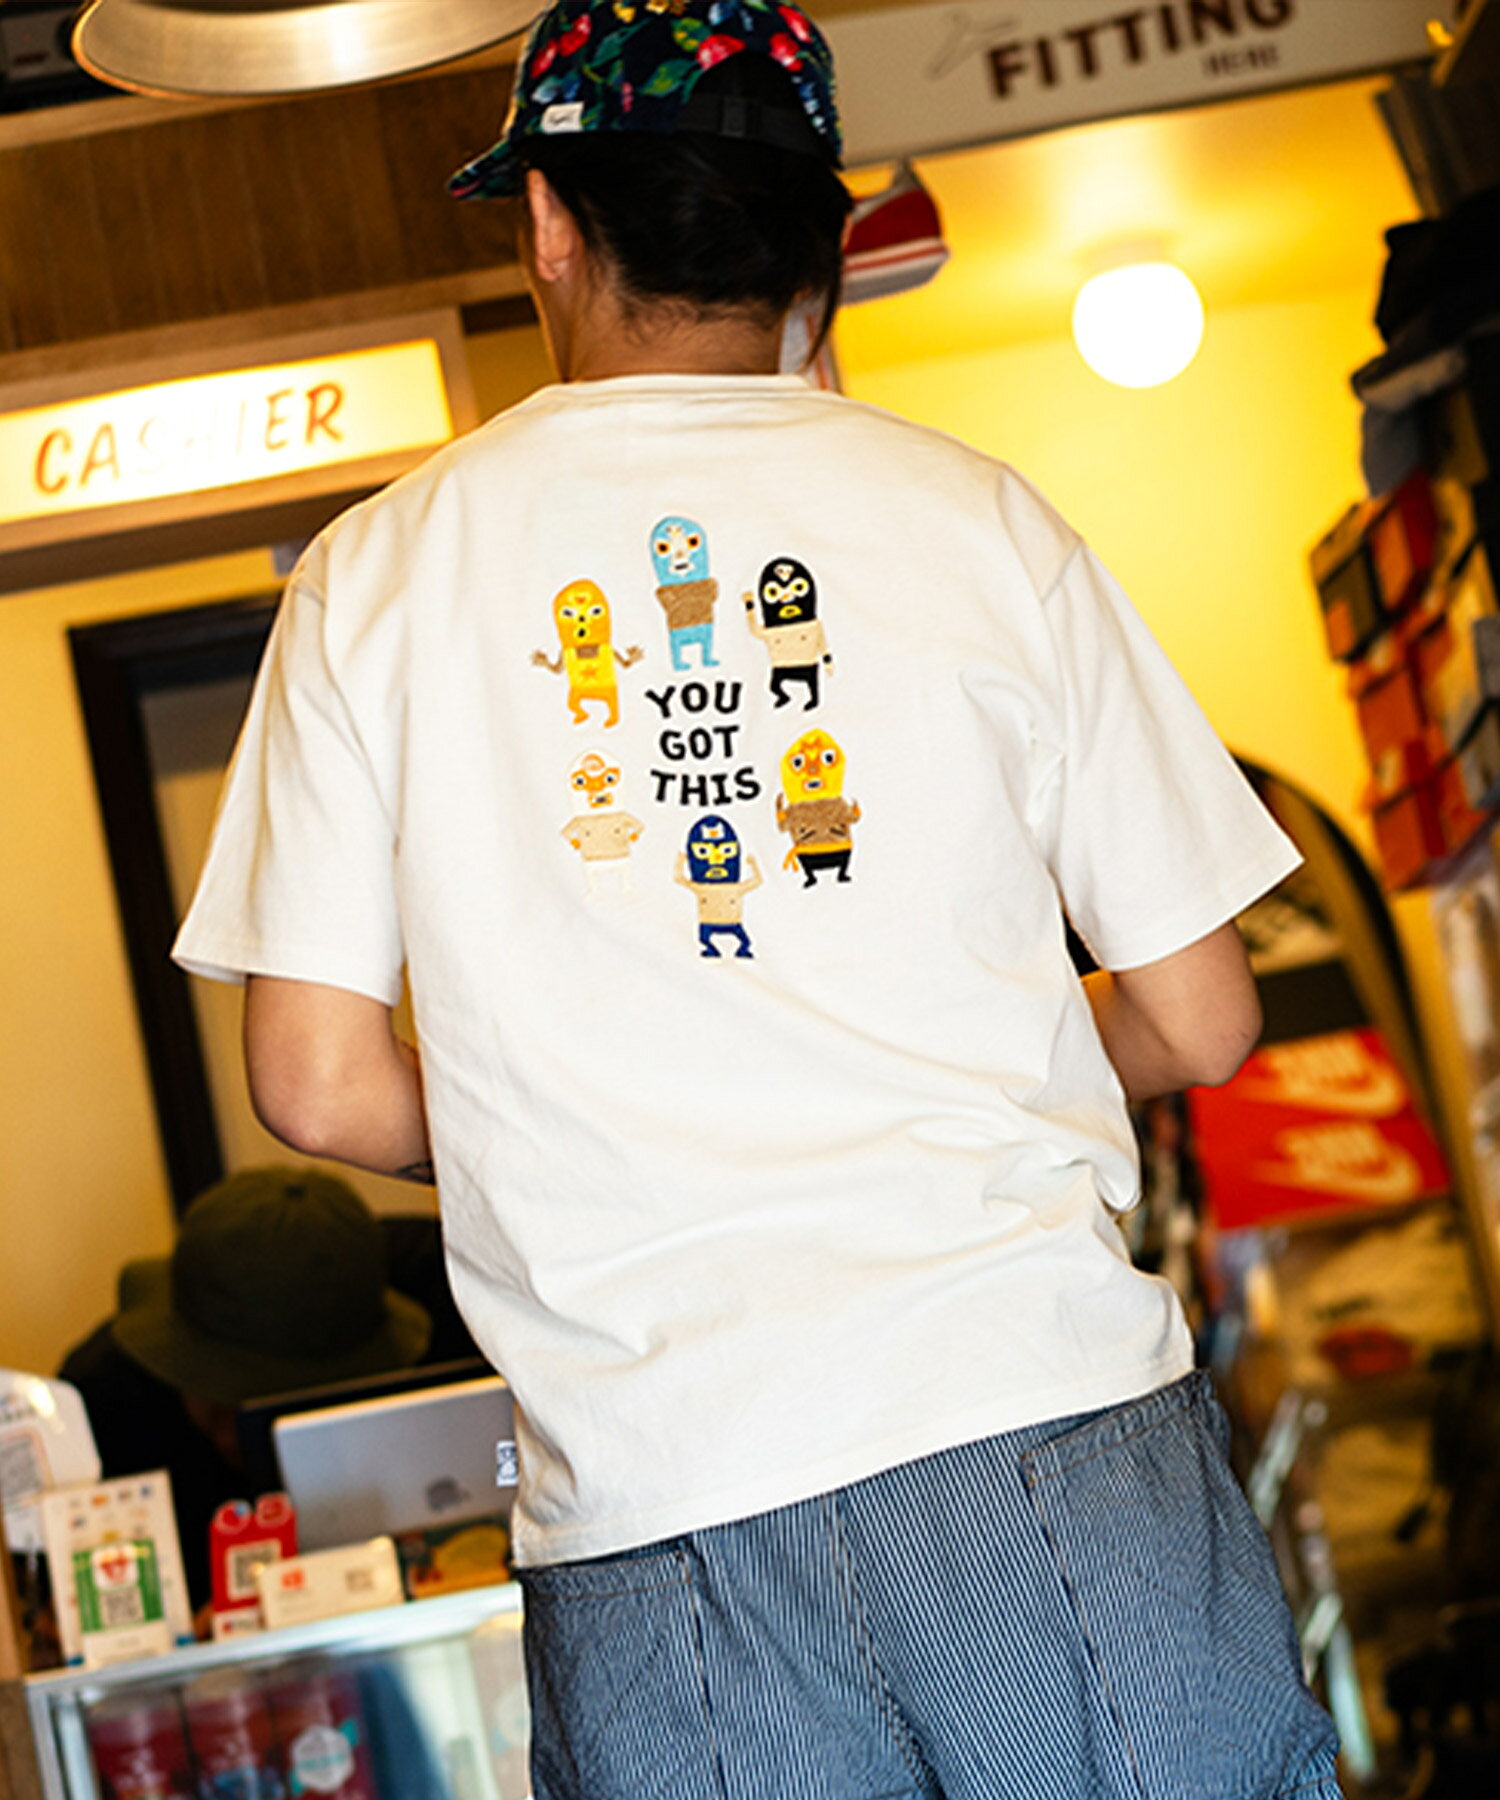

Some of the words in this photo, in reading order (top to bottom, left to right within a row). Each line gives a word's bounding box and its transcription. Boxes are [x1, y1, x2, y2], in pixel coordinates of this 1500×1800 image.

[984, 0, 1292, 99] FITTING
[644, 681, 742, 719] YOU
[659, 725, 739, 761] GOT
[650, 766, 761, 806] THIS
